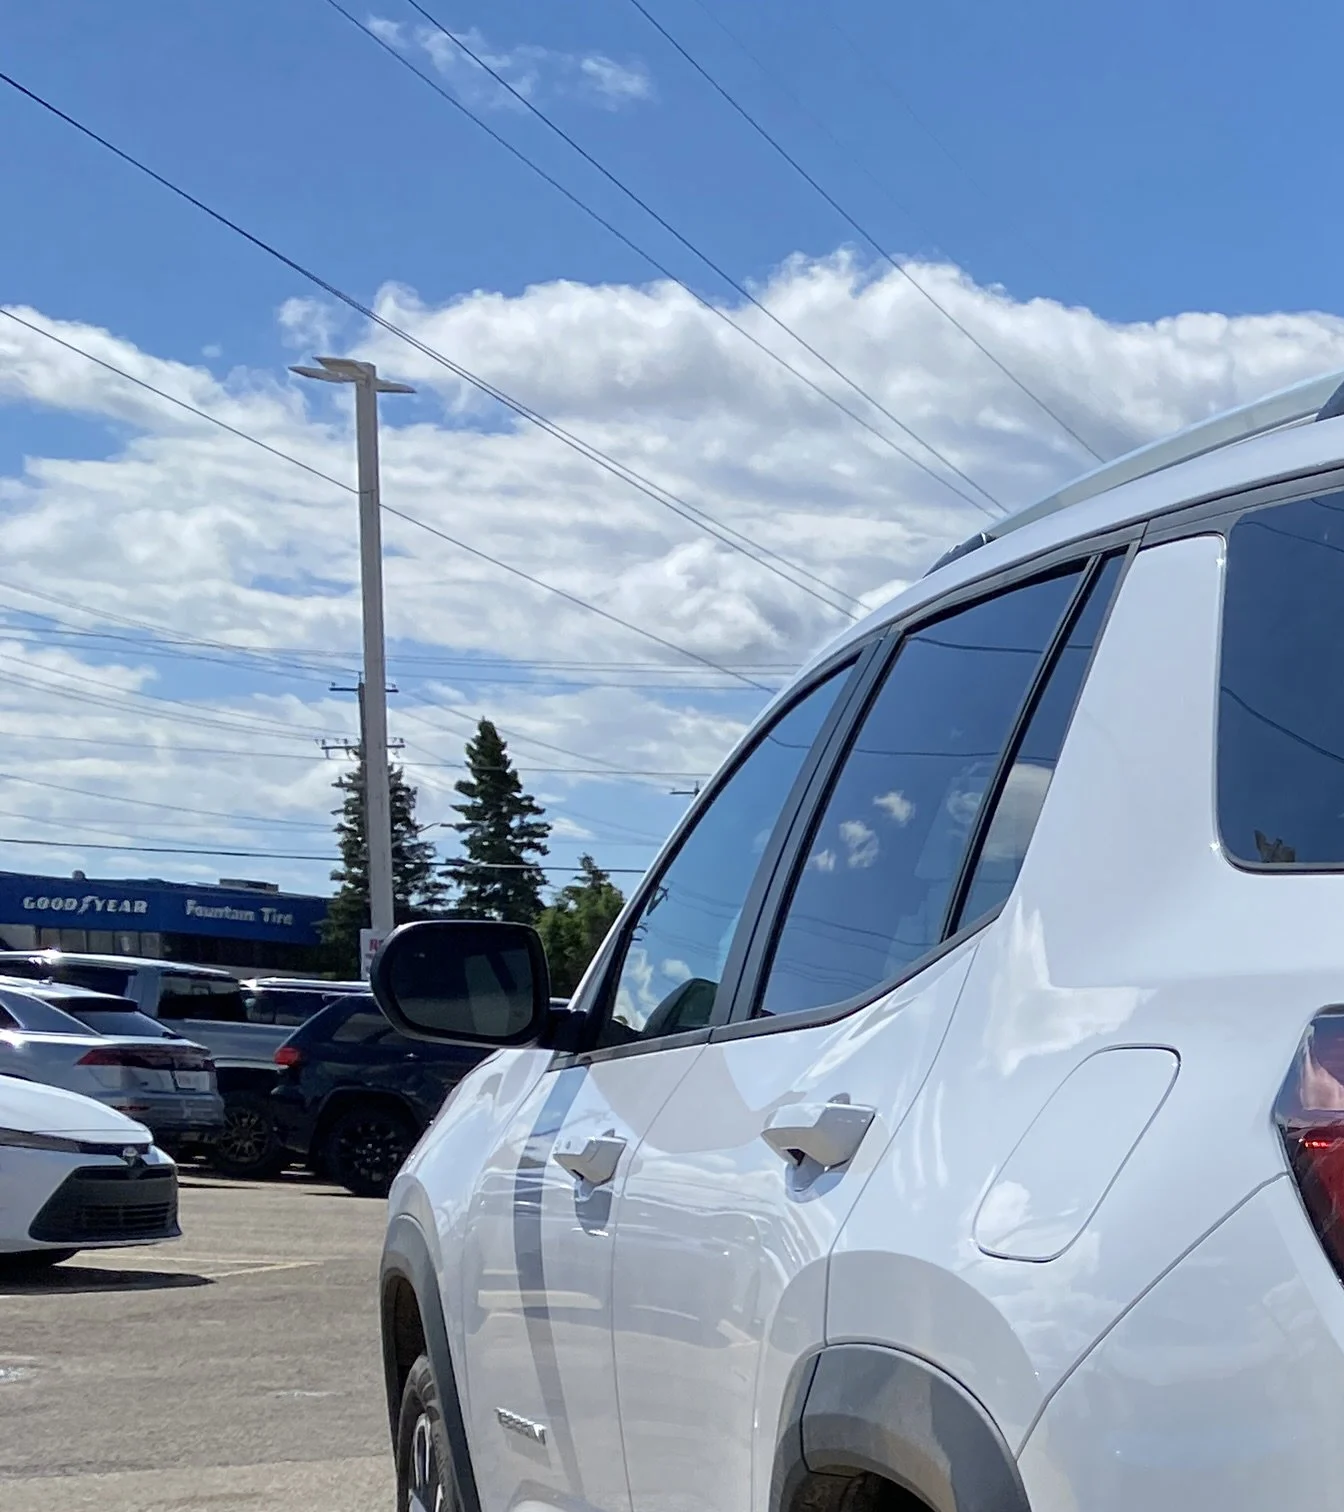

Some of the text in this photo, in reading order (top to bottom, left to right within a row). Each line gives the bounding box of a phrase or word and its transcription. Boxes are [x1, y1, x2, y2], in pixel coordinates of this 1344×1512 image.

[23, 895, 294, 926] GOODYEAR Fountain Tire
